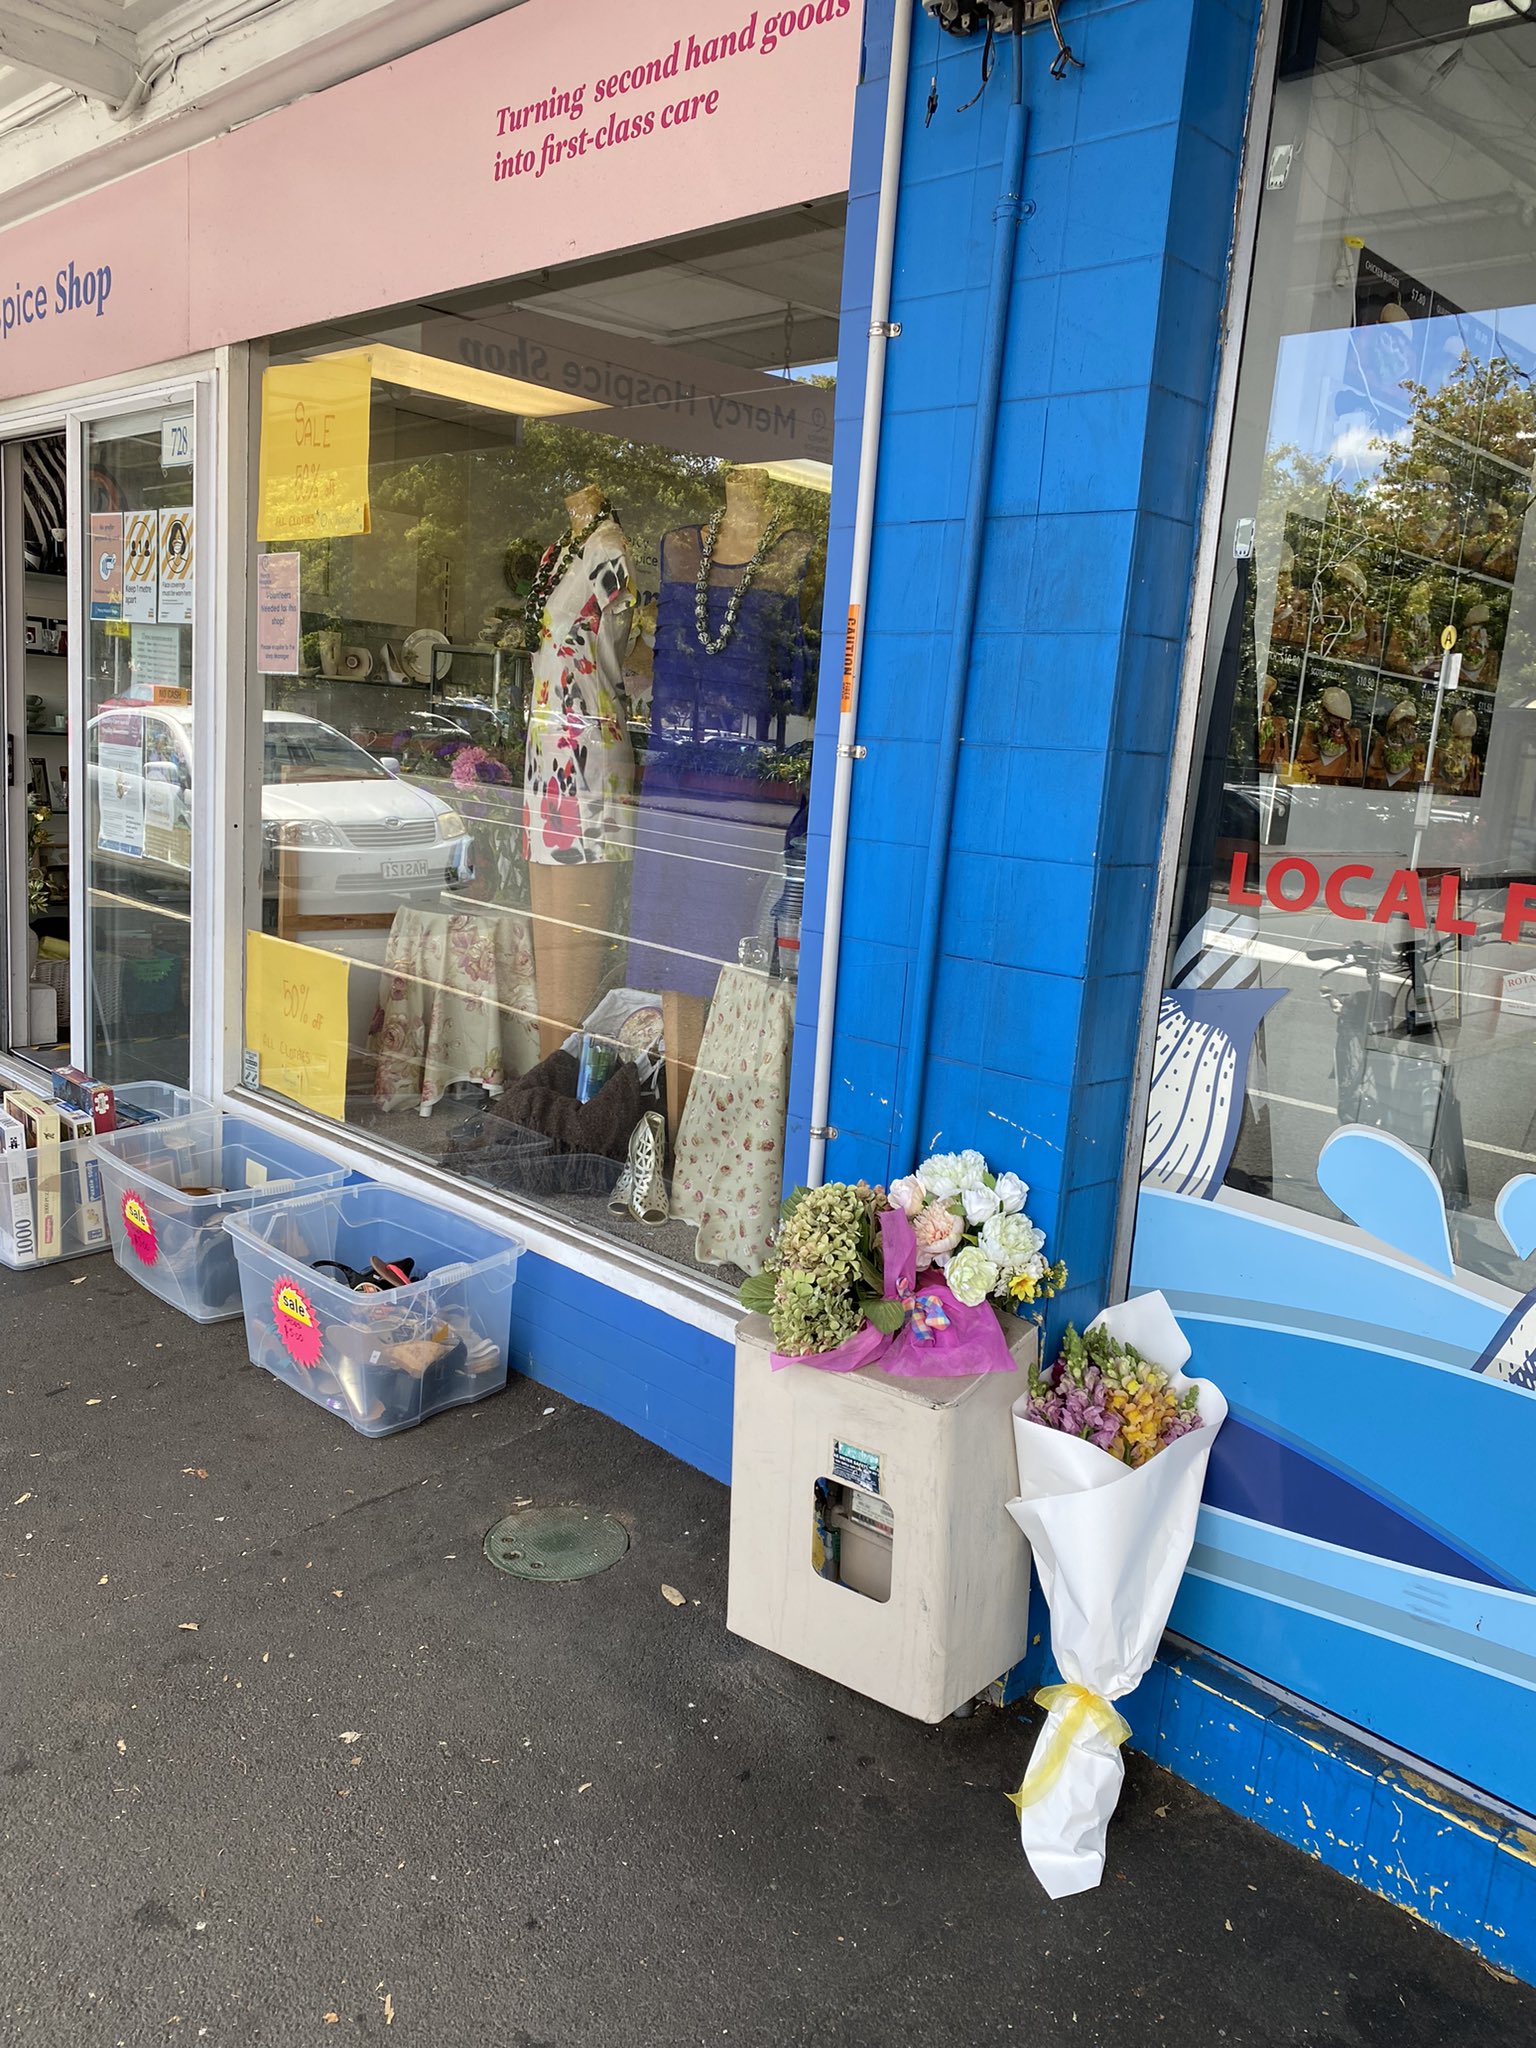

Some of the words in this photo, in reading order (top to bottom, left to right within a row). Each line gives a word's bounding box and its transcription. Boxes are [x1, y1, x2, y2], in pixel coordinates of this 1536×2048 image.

[496, 83, 586, 137] Turning
[594, 40, 681, 103] second
[685, 11, 759, 72] hand
[760, 0, 851, 55] goods
[494, 147, 536, 181] into
[535, 111, 655, 178] first-class
[661, 90, 720, 129] care
[0, 282, 48, 340] pice
[55, 260, 112, 317] Shop
[171, 426, 188, 456] 728
[295, 401, 335, 448] SALE
[125, 585, 136, 594] Keep
[139, 585, 152, 593] metre
[125, 595, 137, 605] apart
[844, 617, 856, 676] CAUTION
[158, 689, 167, 698] NO
[167, 689, 182, 700] CASH
[1228, 852, 1477, 936] LOCAL
[282, 980, 310, 1024] 50%
[312, 1013, 324, 1030] off
[128, 1205, 146, 1226] sale
[15, 1219, 34, 1257] 1000
[282, 1295, 305, 1318] sale
